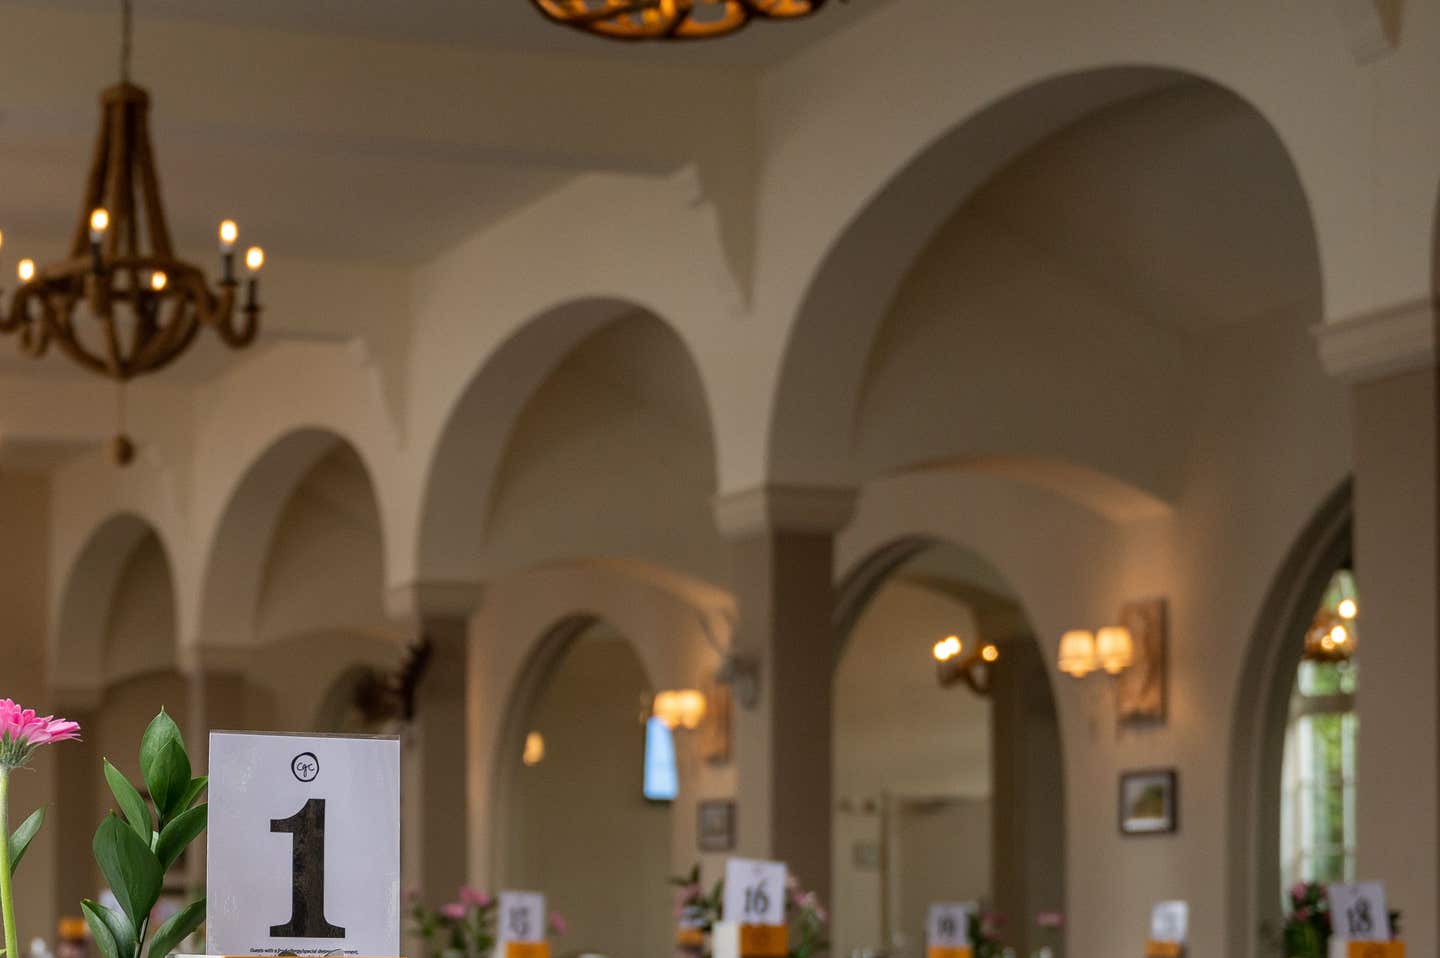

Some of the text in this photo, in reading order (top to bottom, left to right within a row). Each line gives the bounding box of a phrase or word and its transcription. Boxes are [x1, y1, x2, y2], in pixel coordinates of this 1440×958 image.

[296, 762, 315, 777] cgc
[270, 798, 346, 938] 1
[744, 880, 769, 915] 16
